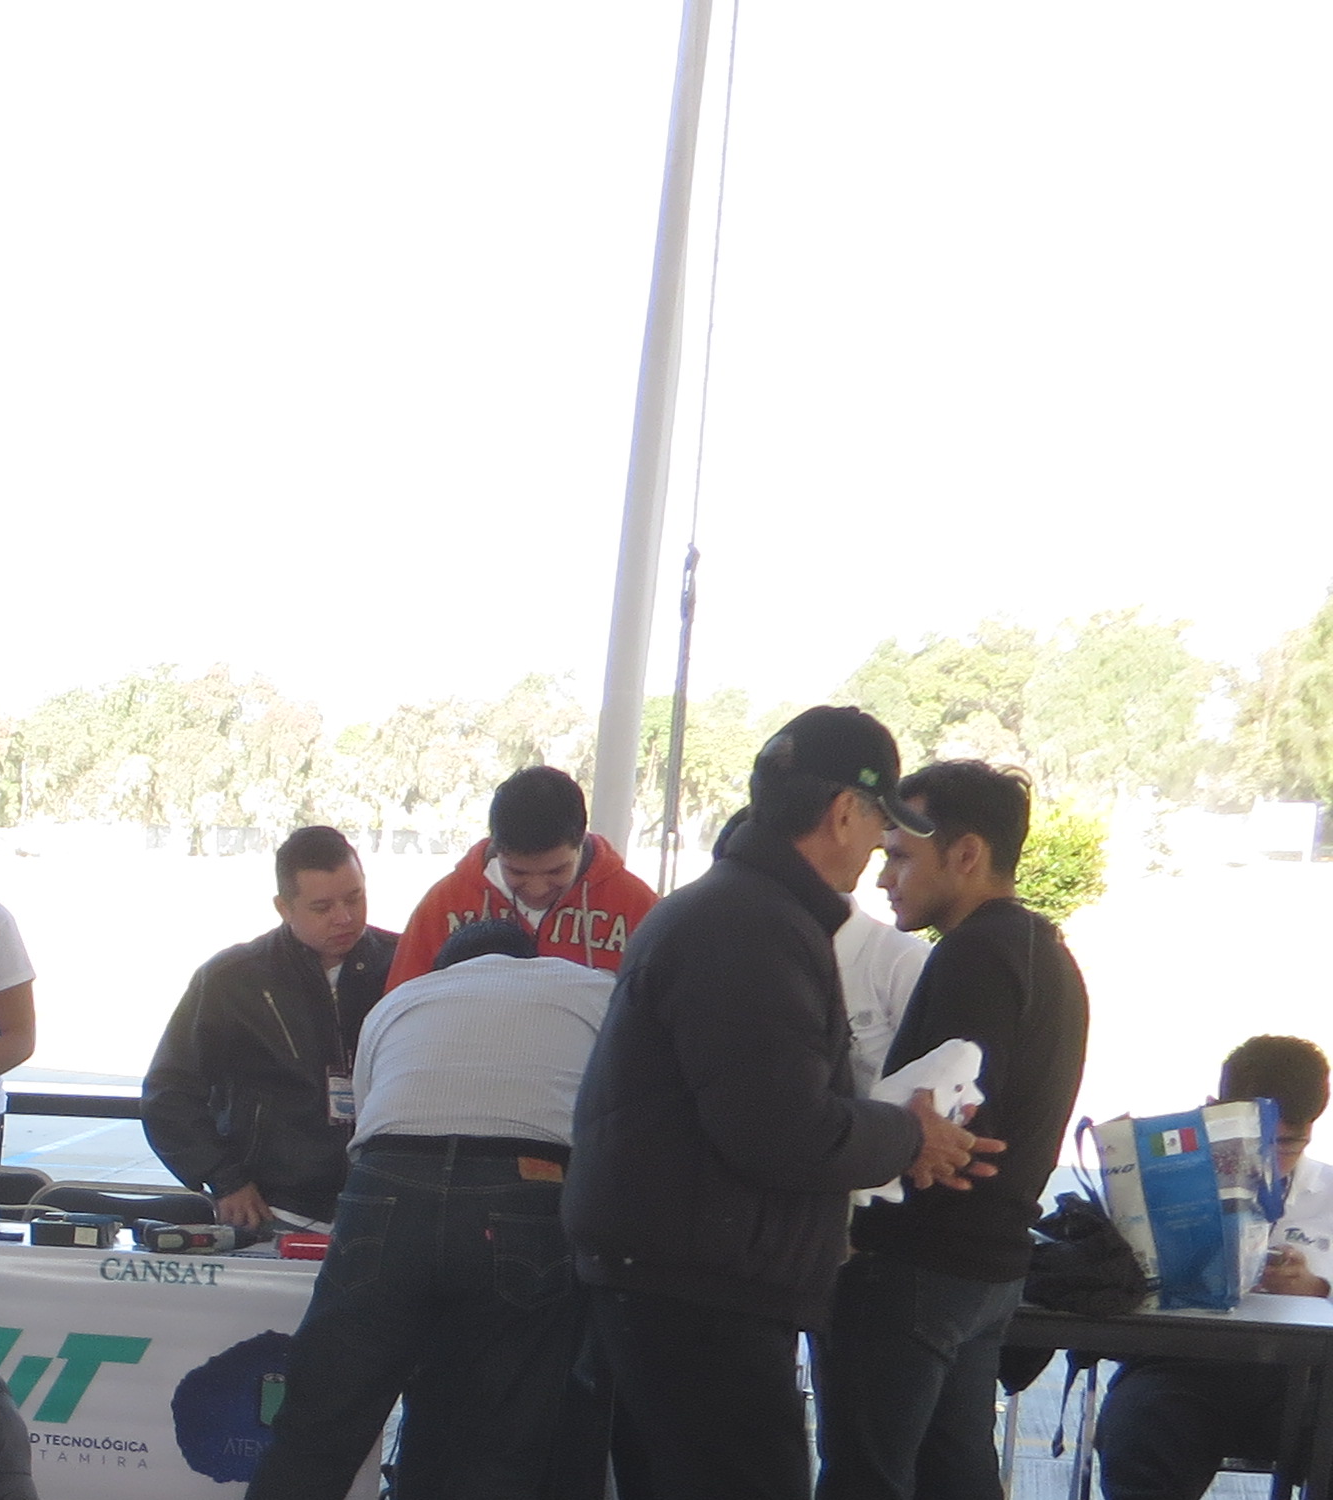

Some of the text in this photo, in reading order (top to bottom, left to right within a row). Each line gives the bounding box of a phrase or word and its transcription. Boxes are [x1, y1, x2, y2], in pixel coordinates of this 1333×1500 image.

[447, 907, 627, 951] NTICA
[99, 1257, 224, 1287] CANSAT
[44, 1433, 149, 1453] TECNOLÓGICA
[39, 1449, 148, 1469] TAMIRA
